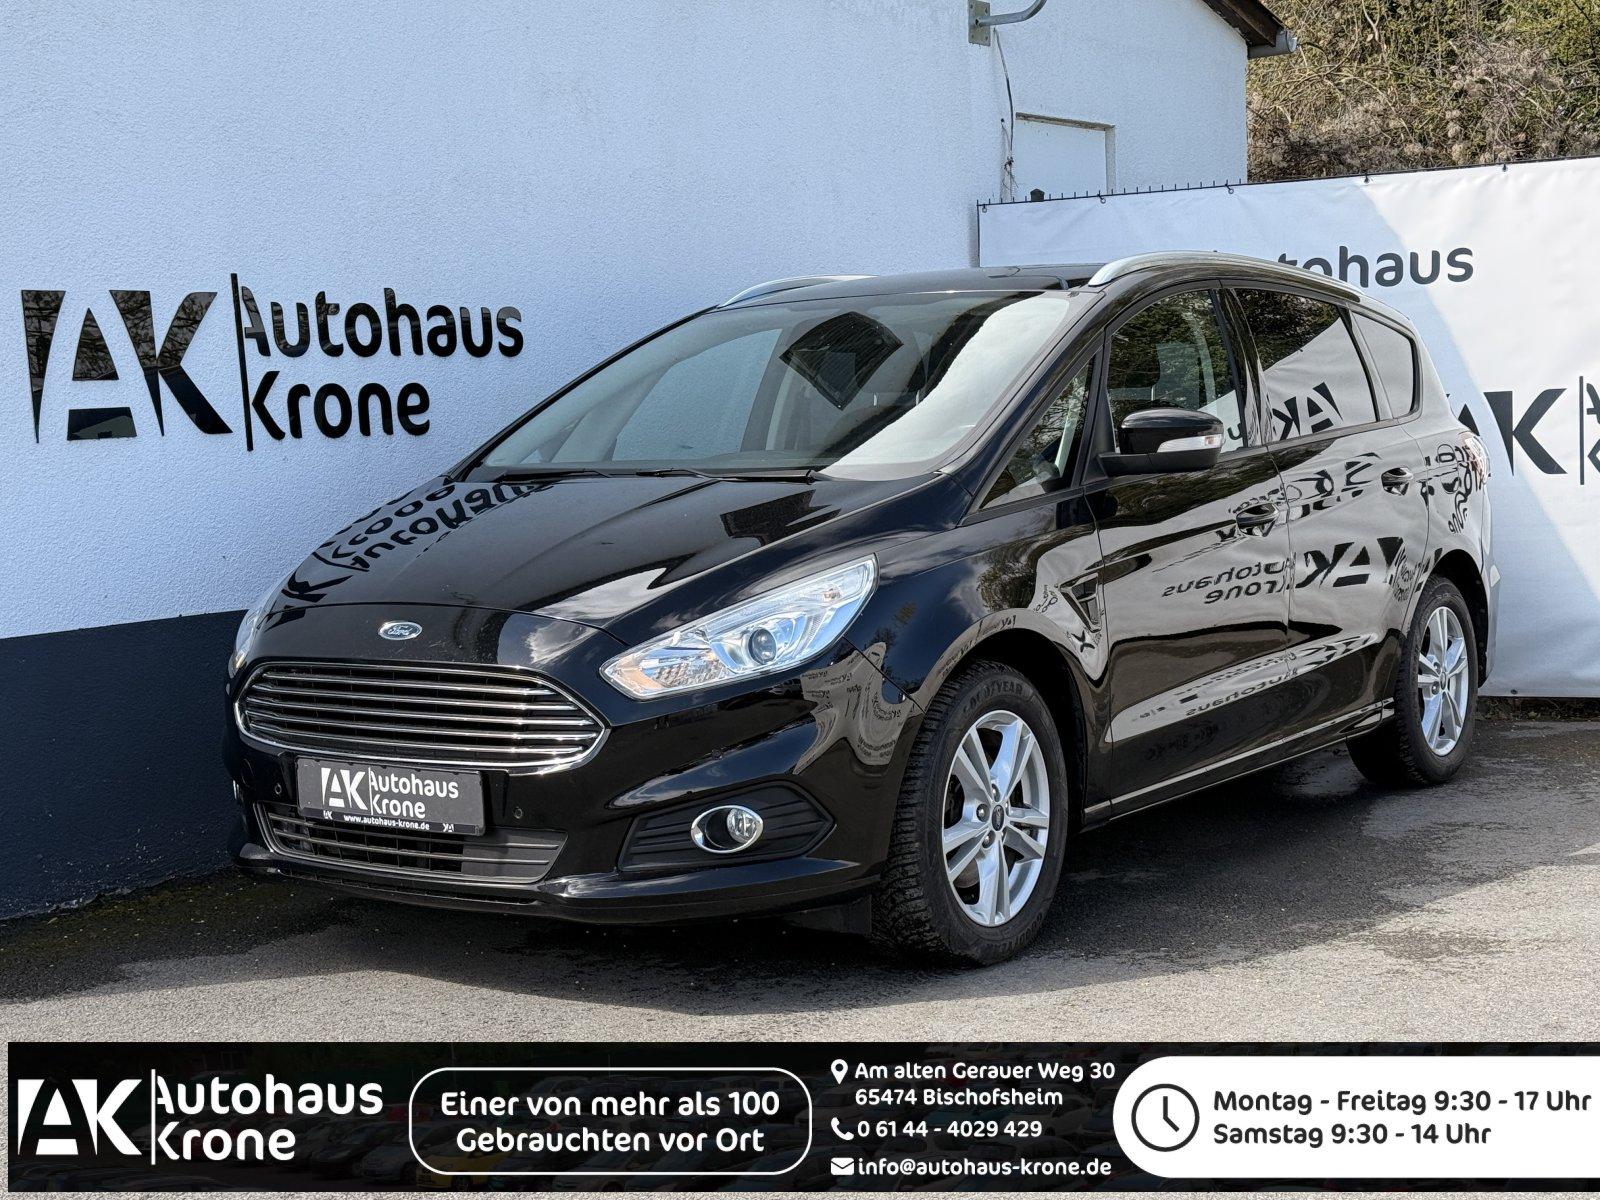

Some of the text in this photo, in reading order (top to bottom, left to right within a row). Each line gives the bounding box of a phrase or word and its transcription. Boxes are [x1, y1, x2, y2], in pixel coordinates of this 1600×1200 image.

[241, 286, 524, 358] Autohaus
[21, 289, 233, 444] AK
[251, 370, 430, 441] Krone
[321, 768, 367, 810] AK
[371, 770, 459, 799] Autohaus
[343, 814, 430, 831] www.autohaus-krone.de
[372, 794, 426, 818] Krone
